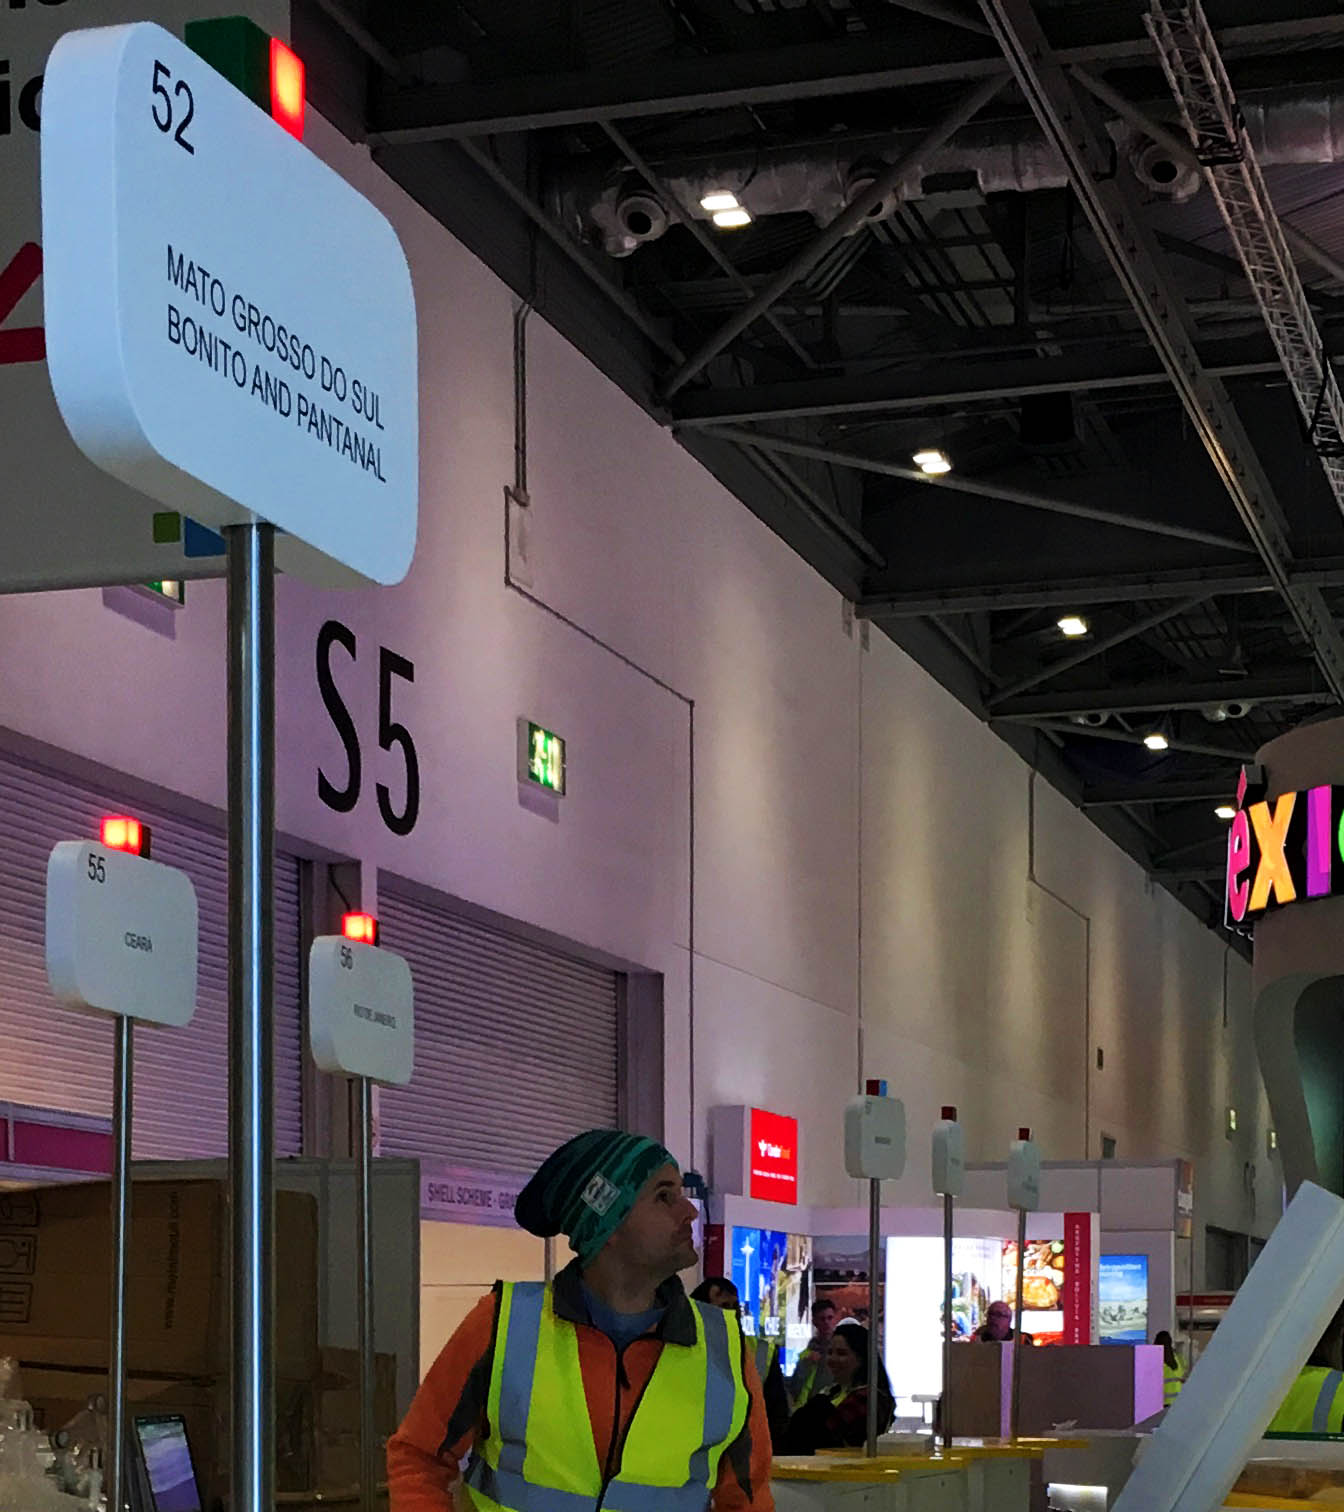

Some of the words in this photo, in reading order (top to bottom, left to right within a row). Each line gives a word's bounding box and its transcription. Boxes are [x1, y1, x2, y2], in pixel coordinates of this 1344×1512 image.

[151, 59, 195, 156] 52
[167, 244, 226, 318] MATO
[232, 294, 316, 380] GROSSO
[320, 355, 347, 403] DO
[352, 378, 385, 431] SUL
[167, 303, 247, 389] BONITO
[250, 364, 292, 418] AND
[296, 392, 387, 483] PANTANAL
[316, 619, 420, 837] S5
[87, 853, 106, 884] 55
[427, 1182, 456, 1204] SHELL
[457, 1186, 493, 1208] SCHEME
